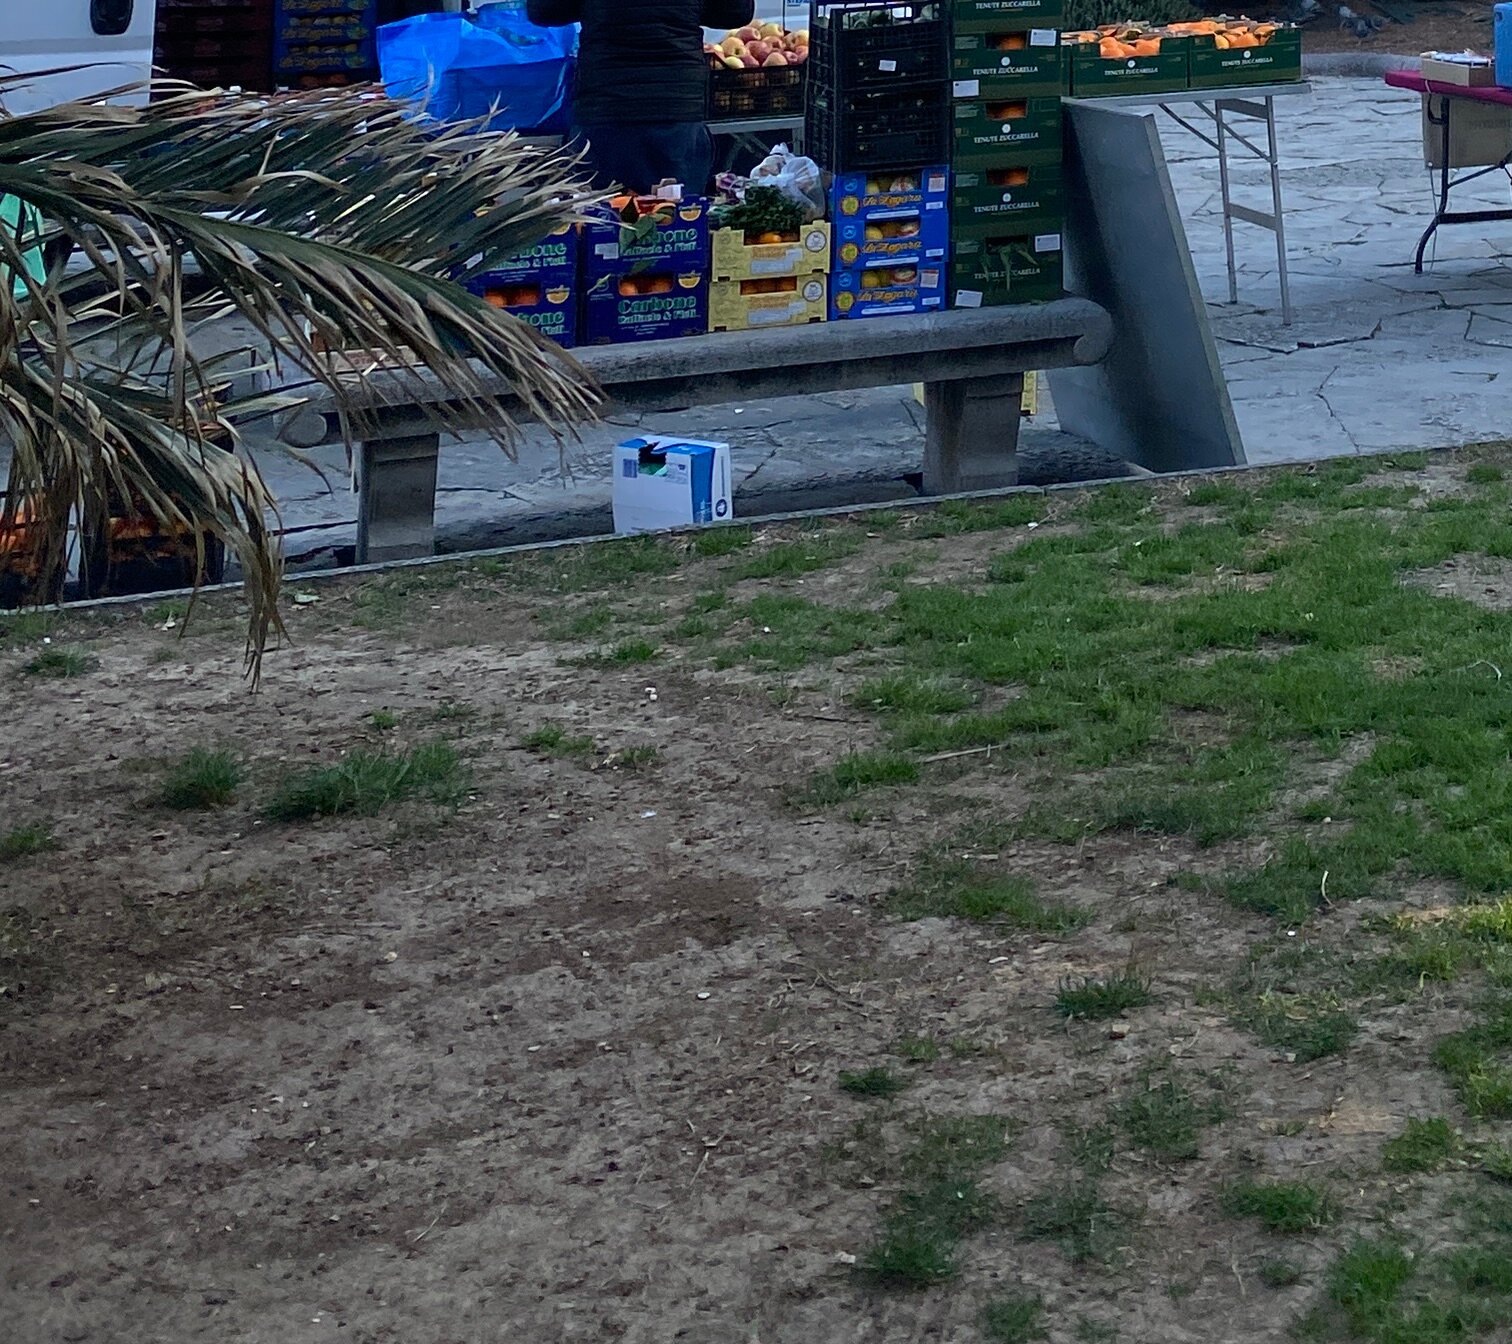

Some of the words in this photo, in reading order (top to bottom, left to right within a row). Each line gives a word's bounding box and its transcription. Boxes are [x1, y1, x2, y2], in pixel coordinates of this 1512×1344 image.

[1001, 0, 1041, 8] ZUCCARELLA
[998, 66, 1039, 74] ZUCCARELLA
[974, 136, 998, 144] TENUTE
[999, 132, 1039, 142] ZUCCARELLA
[973, 205, 998, 213] TENUTE
[1000, 201, 1040, 211] ZUCCARELLA
[618, 295, 697, 314] Carbone
